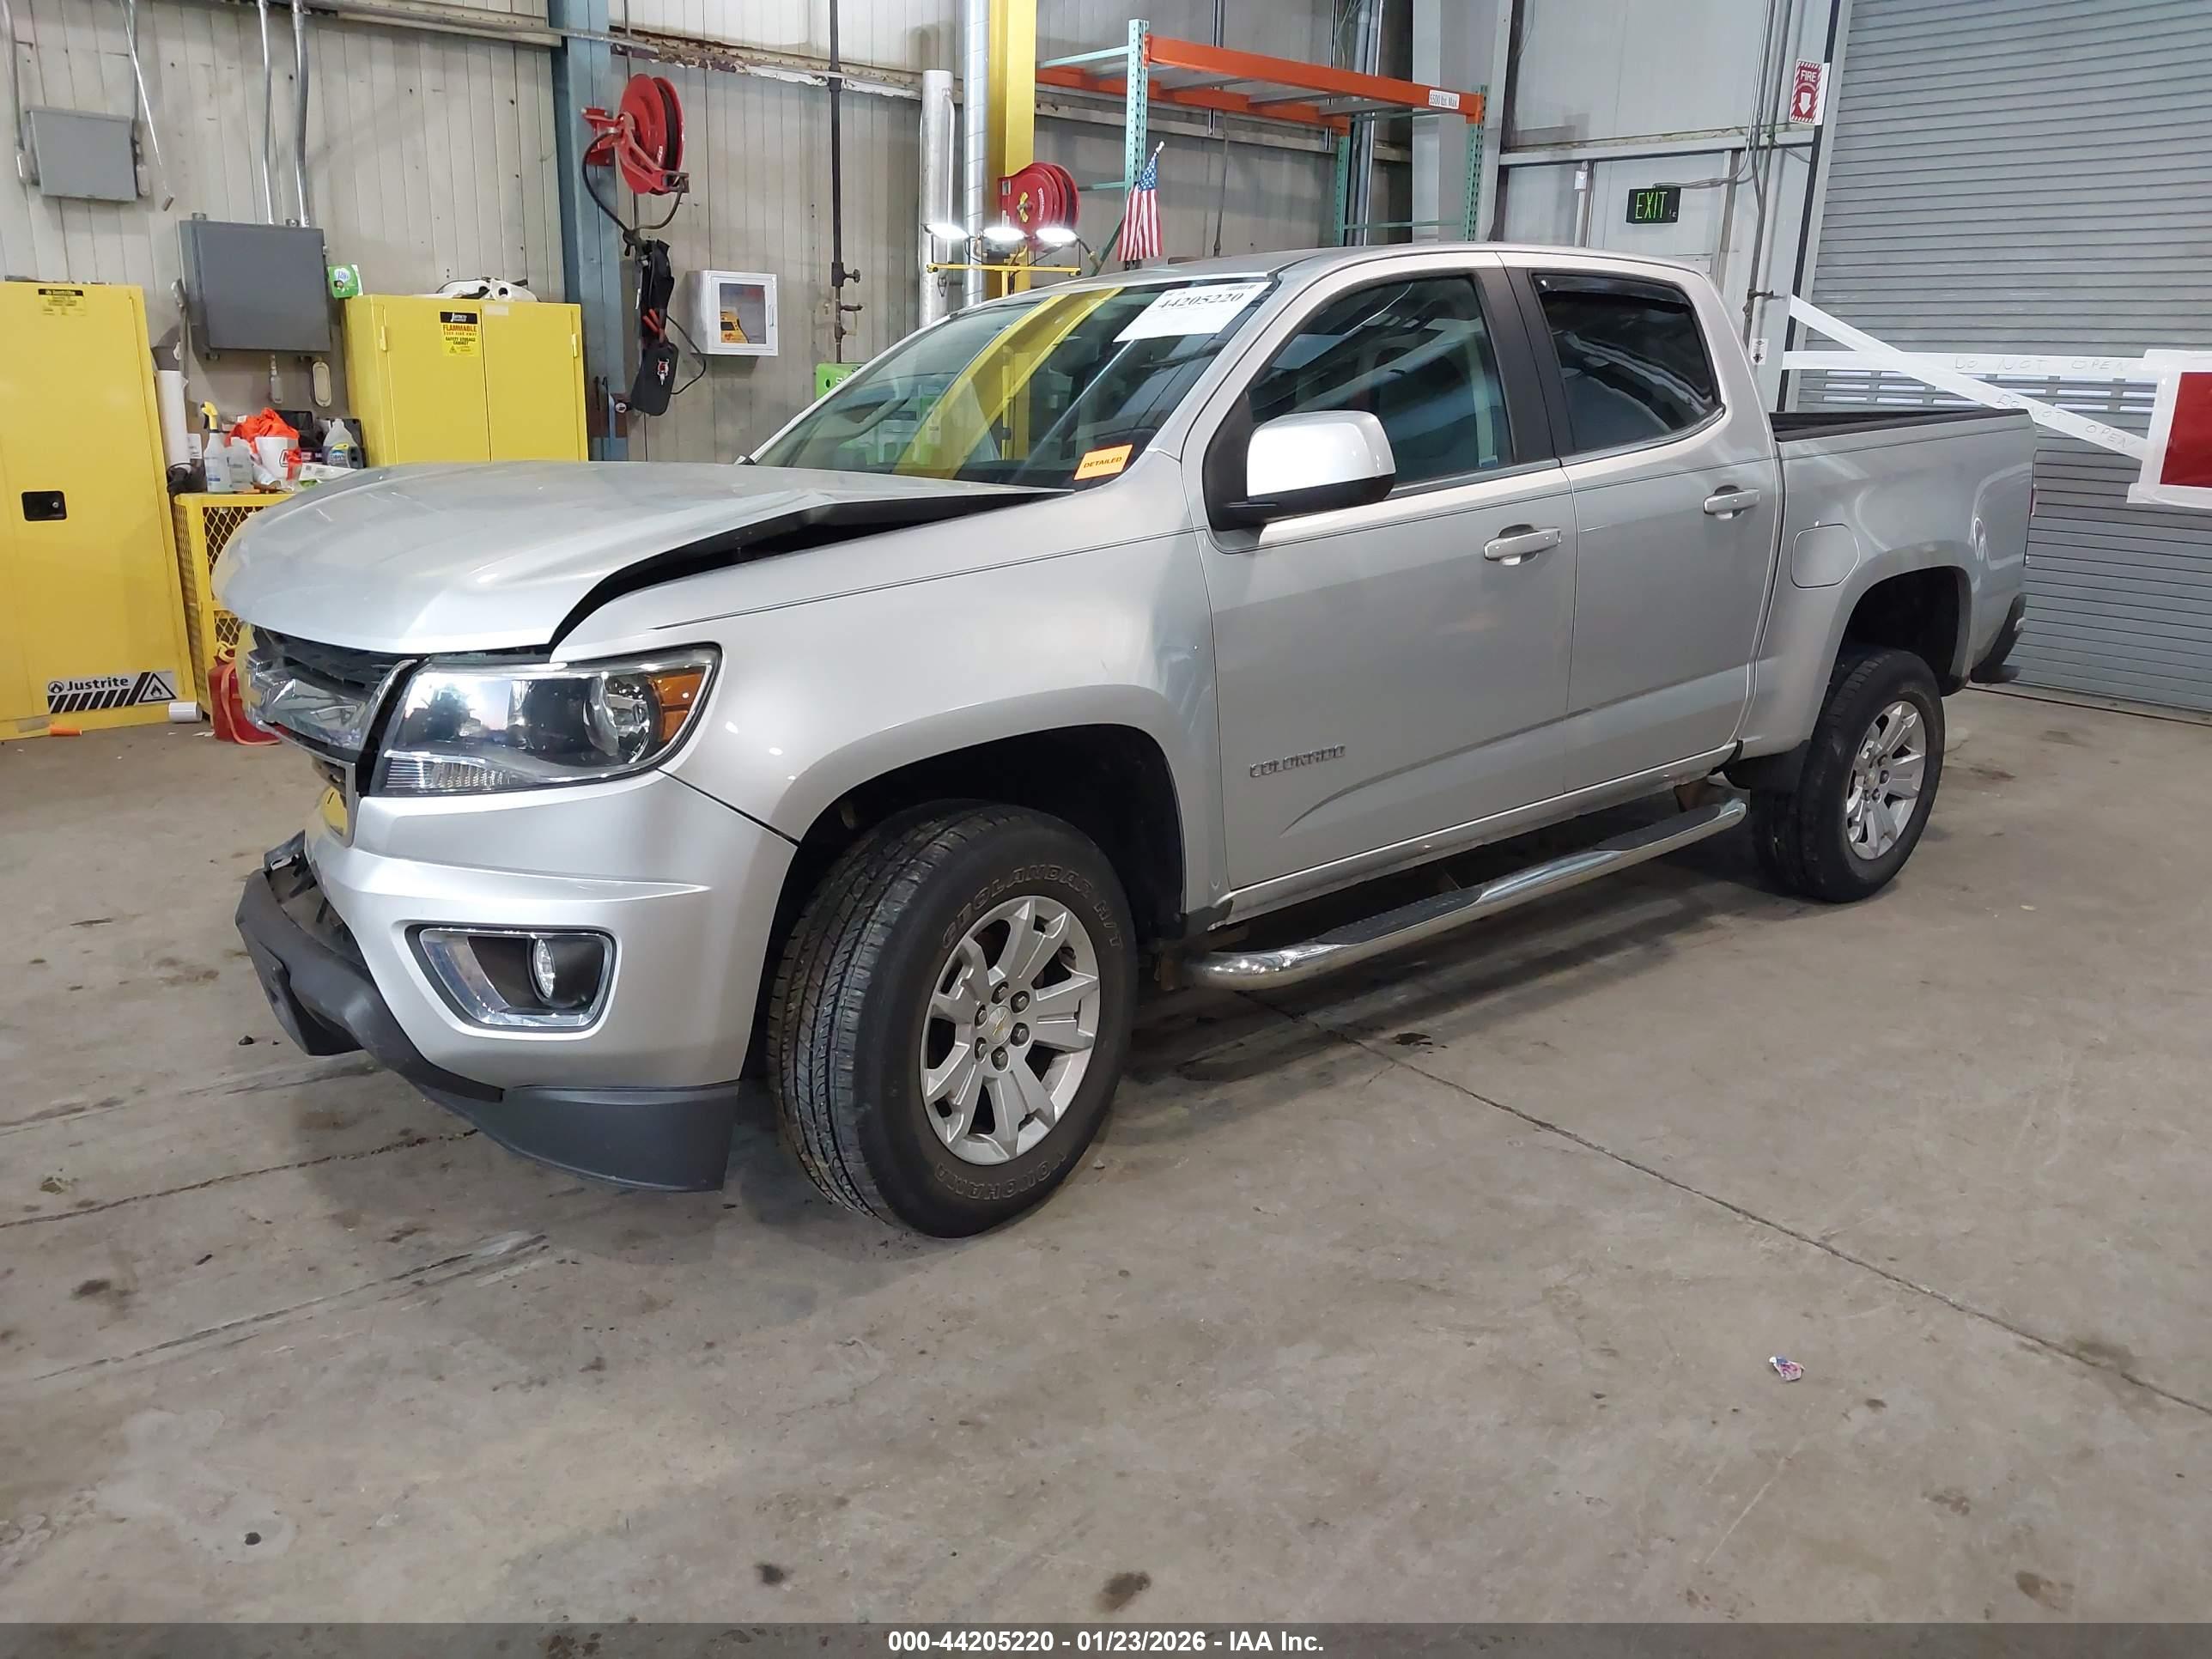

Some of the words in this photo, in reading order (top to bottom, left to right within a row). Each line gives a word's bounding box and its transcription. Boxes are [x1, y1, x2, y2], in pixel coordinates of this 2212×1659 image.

[1800, 70, 1818, 82] FIRE
[1635, 191, 1668, 219] EXIT
[1158, 292, 1244, 309] 44205220
[1996, 357, 2048, 371] NOT
[2070, 359, 2130, 372] OPEN
[2086, 424, 2136, 448] OPEN
[1084, 456, 1122, 469] DETAILED
[66, 677, 129, 691] Justrite
[1249, 743, 1346, 778] COLORADO
[934, 1152, 1067, 1200] YOKOHAMA
